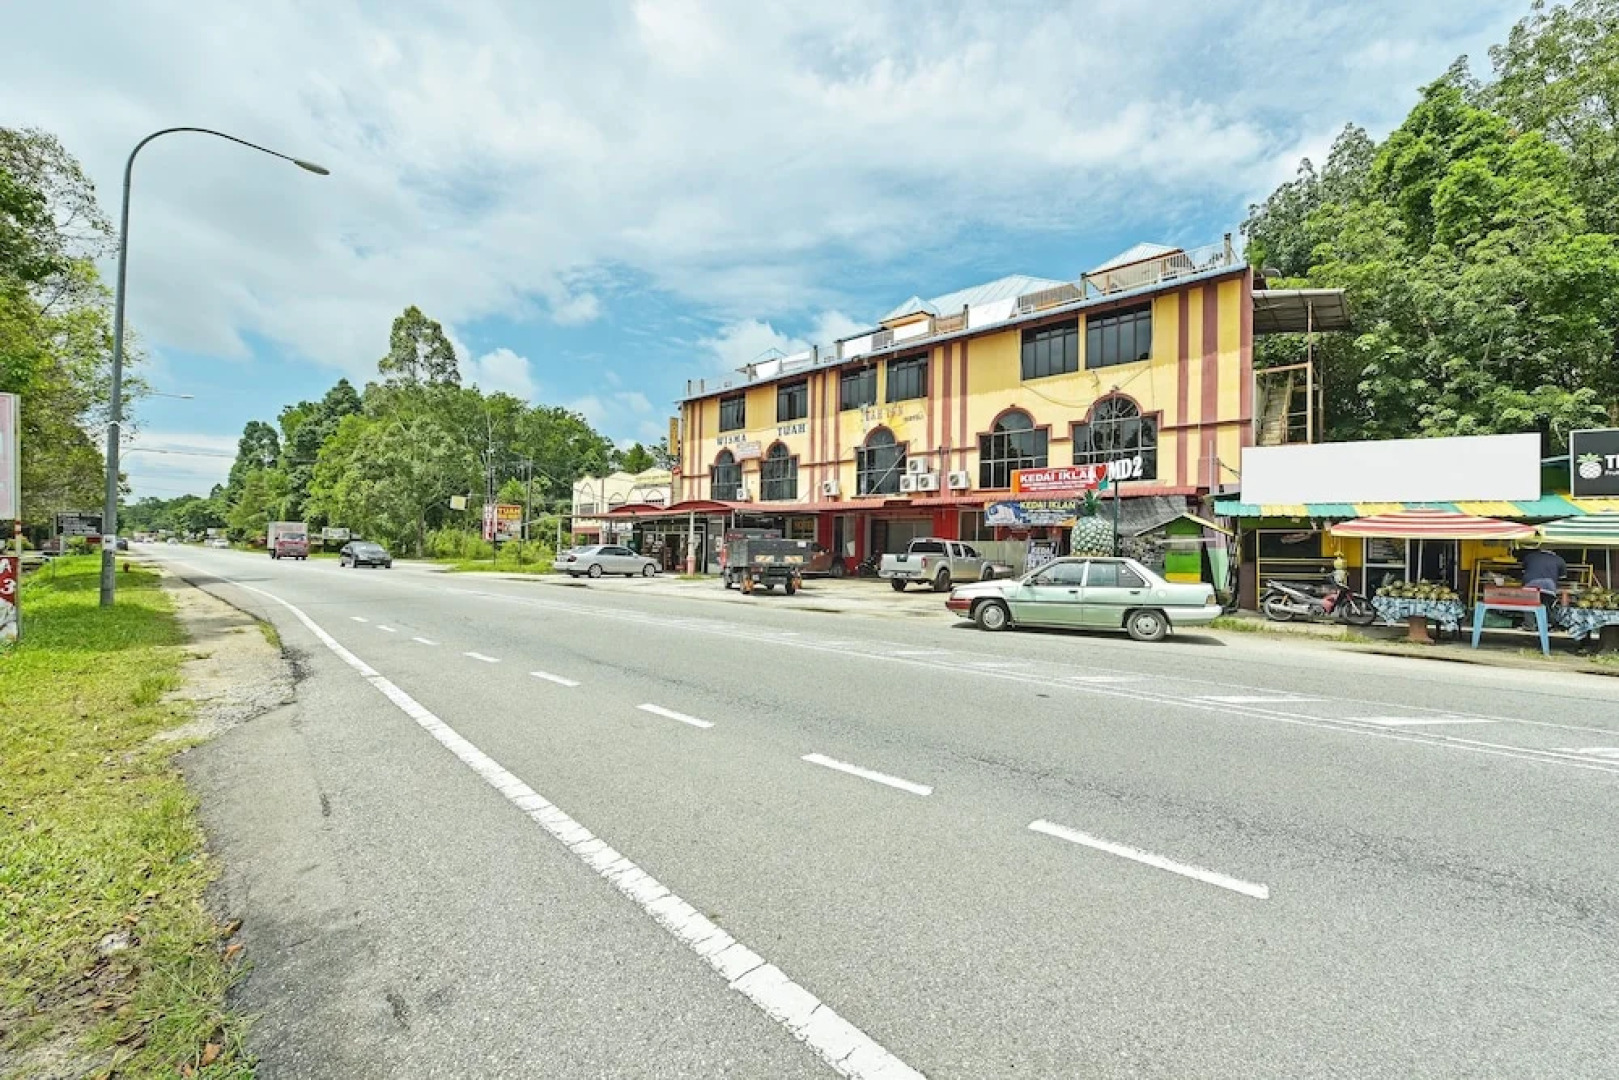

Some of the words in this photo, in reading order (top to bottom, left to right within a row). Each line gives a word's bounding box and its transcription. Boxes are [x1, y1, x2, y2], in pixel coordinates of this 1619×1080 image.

[778, 423, 806, 437] TUAH
[1020, 472, 1055, 483] KEDAI
[1058, 469, 1096, 481] IKLA
[1108, 456, 1143, 482] MD2
[1020, 502, 1045, 510] KEDAI
